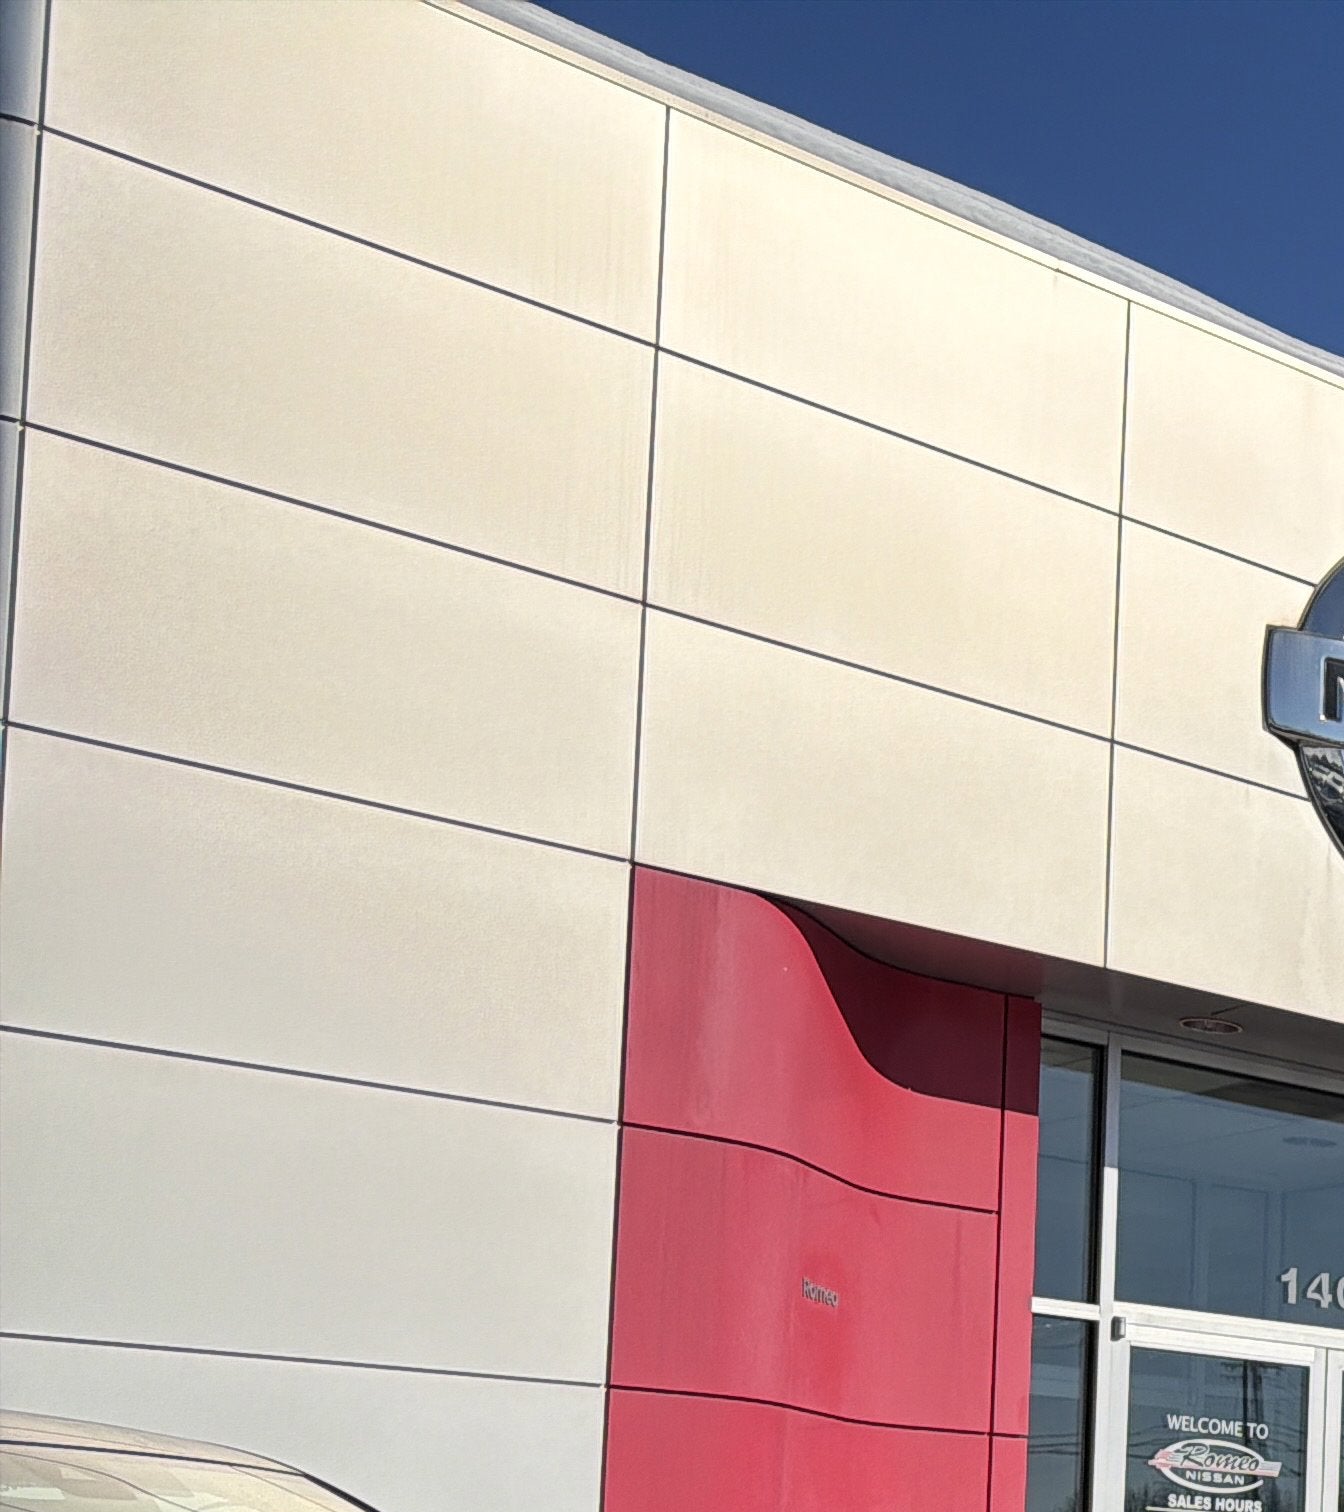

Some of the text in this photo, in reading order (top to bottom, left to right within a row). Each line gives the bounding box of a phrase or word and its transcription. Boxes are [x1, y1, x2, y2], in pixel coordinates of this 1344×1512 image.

[801, 1276, 839, 1309] Romeo
[1166, 1414, 1269, 1440] WELCOME TO
[1175, 1442, 1261, 1472] Romeo
[1186, 1470, 1245, 1486] NISSAN
[1168, 1494, 1212, 1511] SALES
